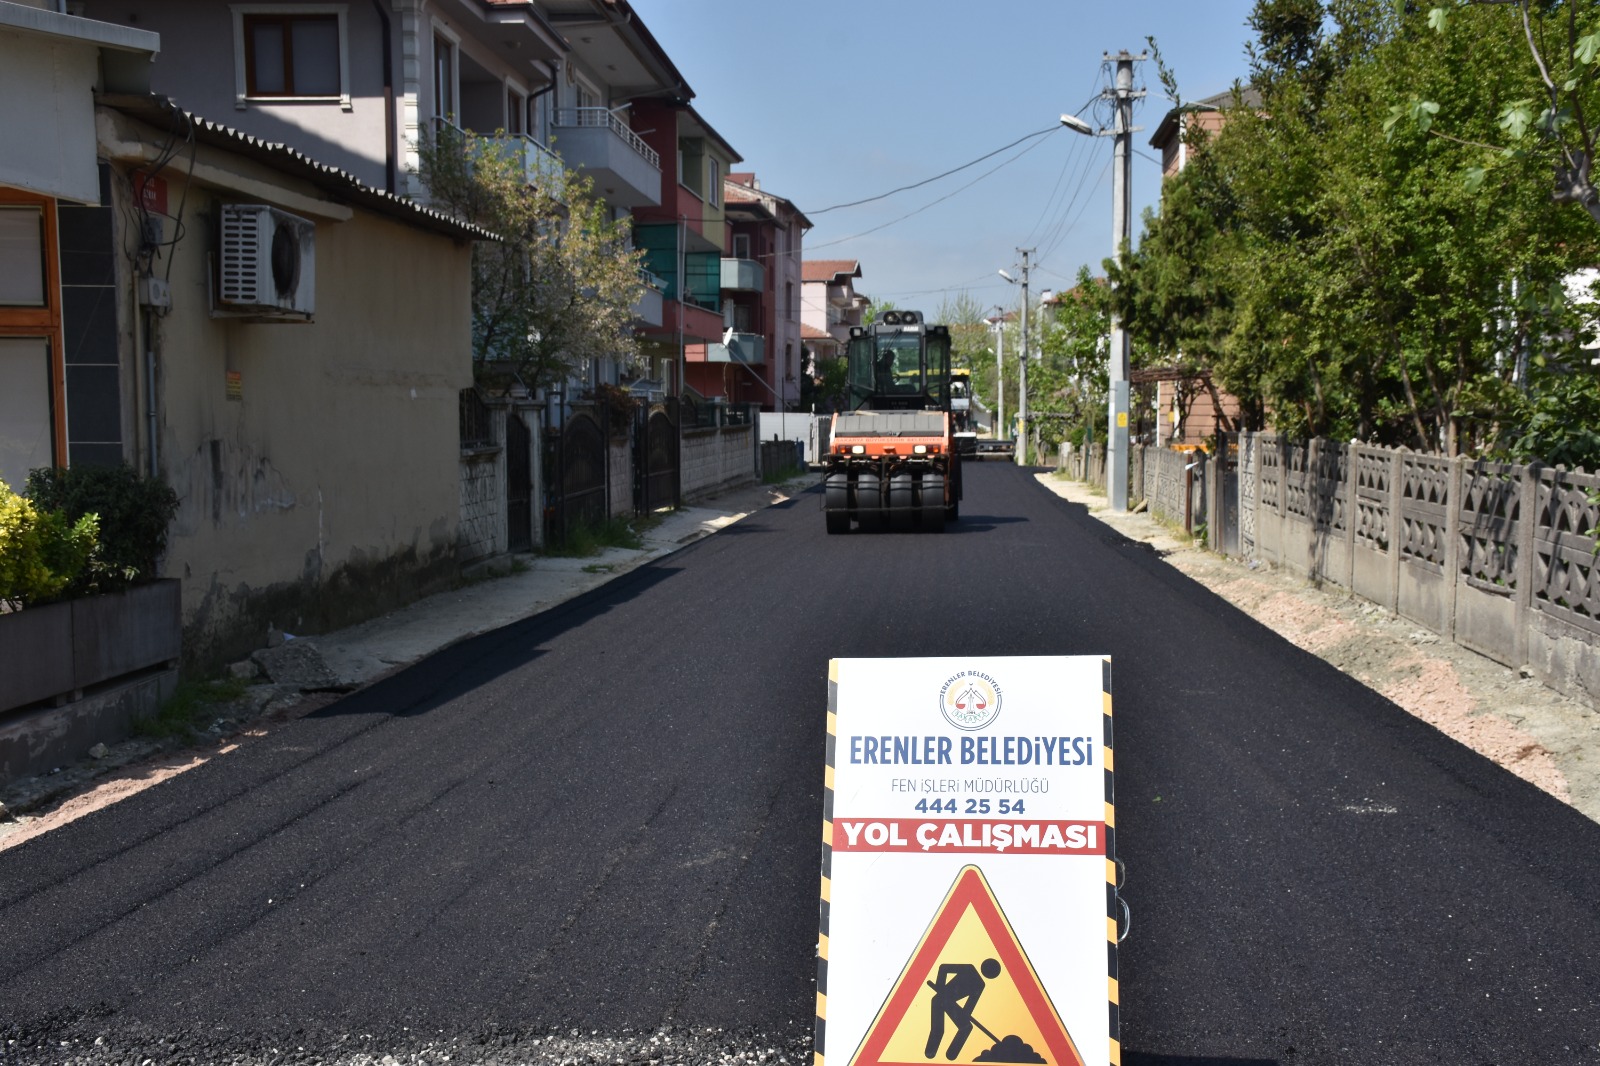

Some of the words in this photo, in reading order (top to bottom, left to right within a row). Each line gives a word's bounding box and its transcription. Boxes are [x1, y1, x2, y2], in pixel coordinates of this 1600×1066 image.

[940, 671, 966, 694] ERENLER
[850, 736, 952, 764] ERENLER
[960, 736, 1093, 765] BELEDİYESİ
[891, 778, 916, 792] FEN
[920, 778, 960, 794] İŞLERİ
[964, 777, 1049, 793] MÜDÜRLÜĞÜ
[914, 798, 957, 813] 444
[965, 798, 990, 814] 25
[998, 798, 1025, 814] 54
[842, 822, 908, 846] YOL
[916, 822, 1097, 852] ÇALIŞMASI
